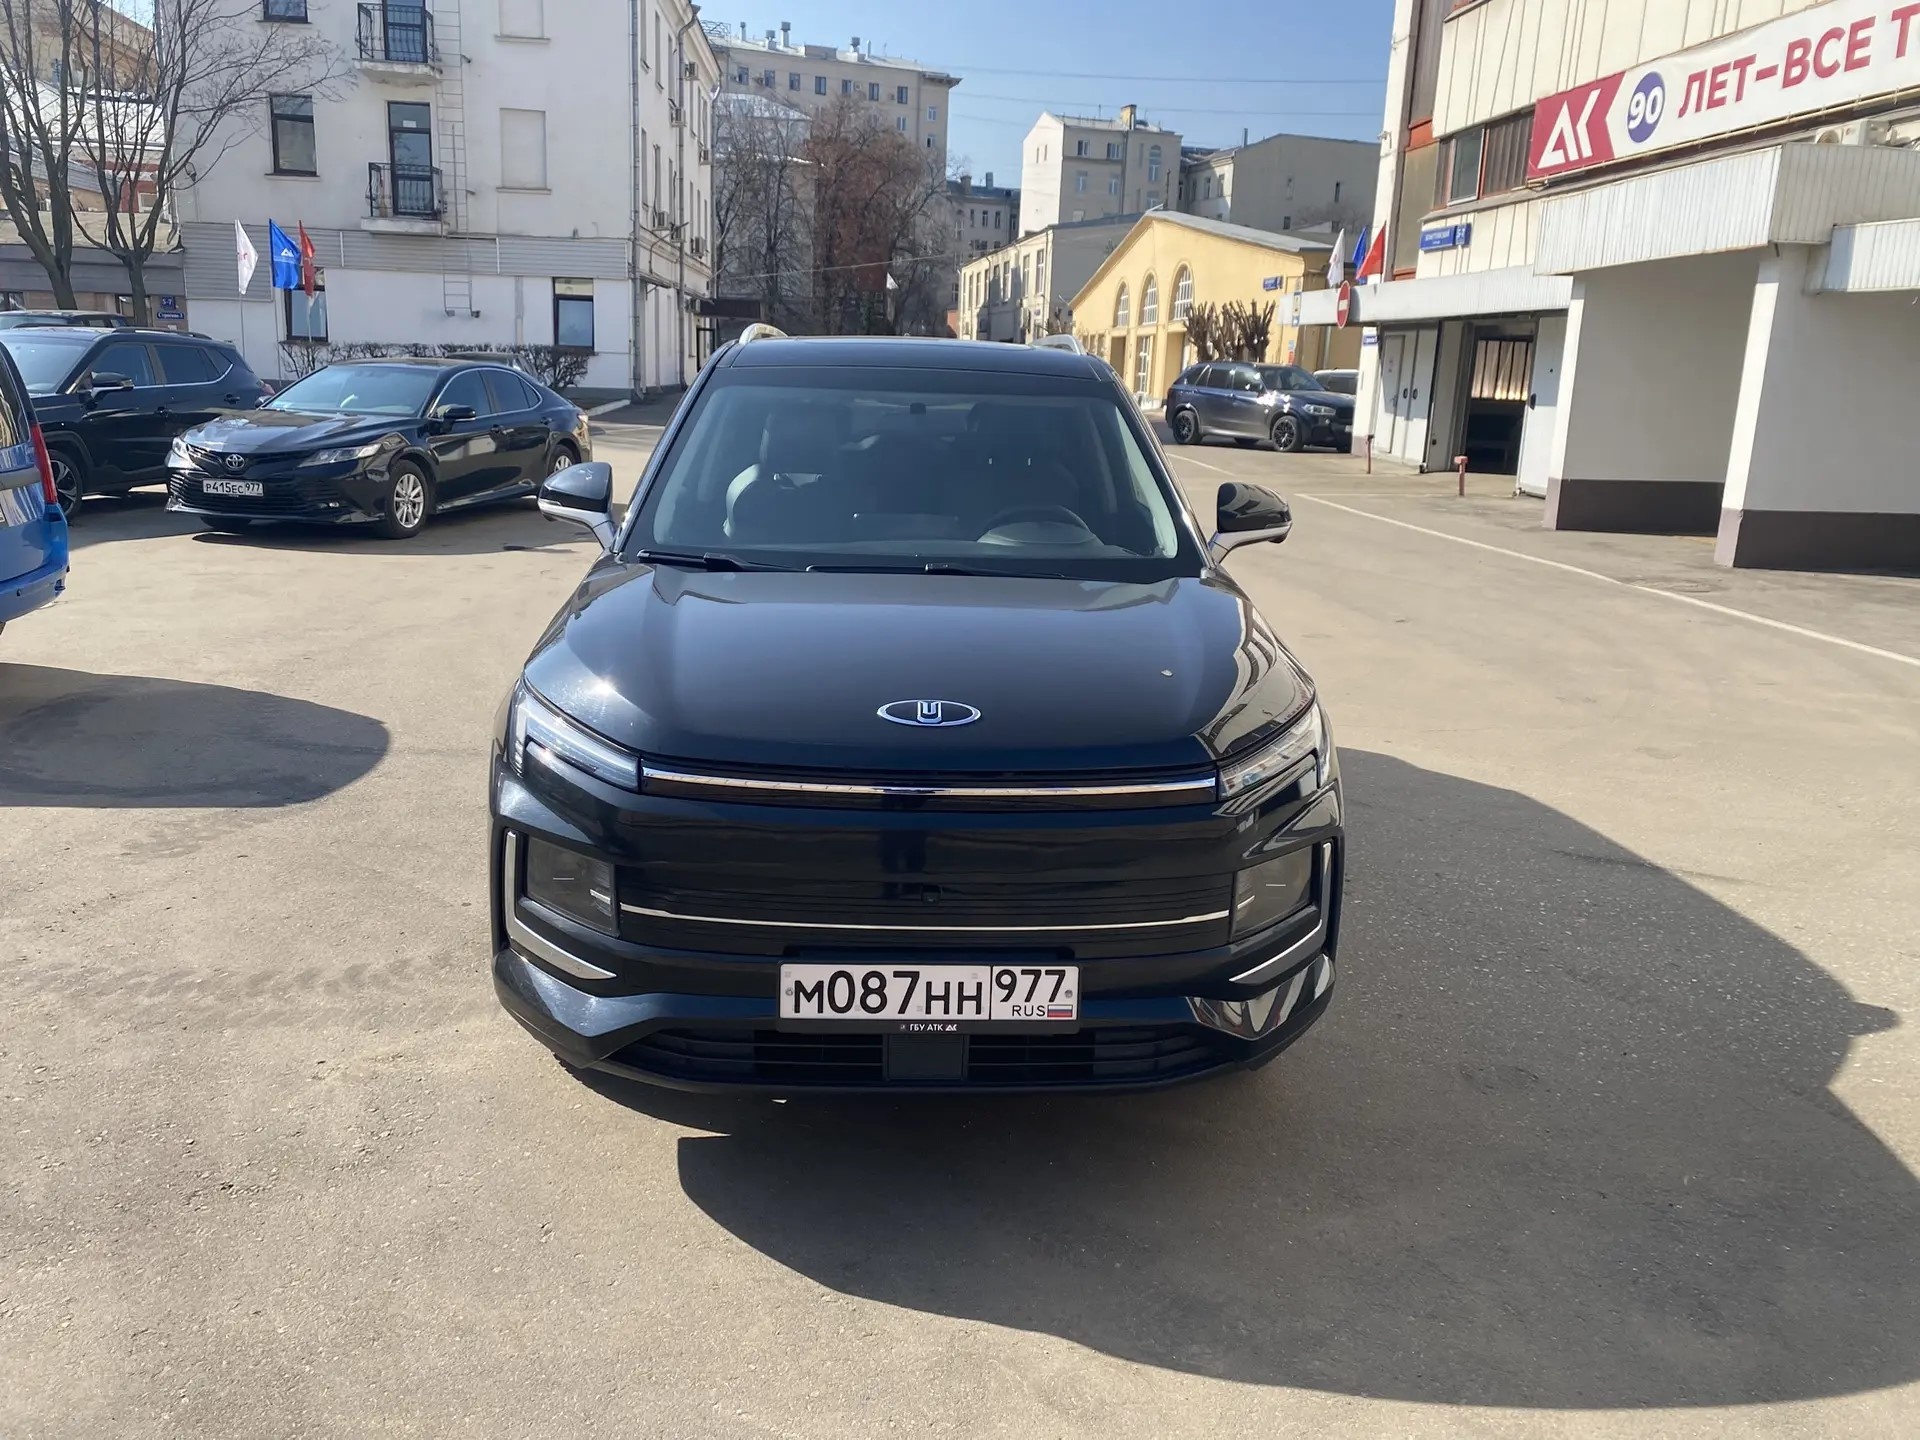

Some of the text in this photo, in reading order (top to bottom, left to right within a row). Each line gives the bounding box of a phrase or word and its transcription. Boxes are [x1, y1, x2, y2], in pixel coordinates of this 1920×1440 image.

[1627, 85, 1662, 131] 90
[245, 482, 260, 492] 977
[794, 969, 1066, 1016] М087НН 977
[1012, 1005, 1046, 1017] RUS
[909, 1023, 926, 1032] ГБУ
[926, 1023, 944, 1032] АТК
